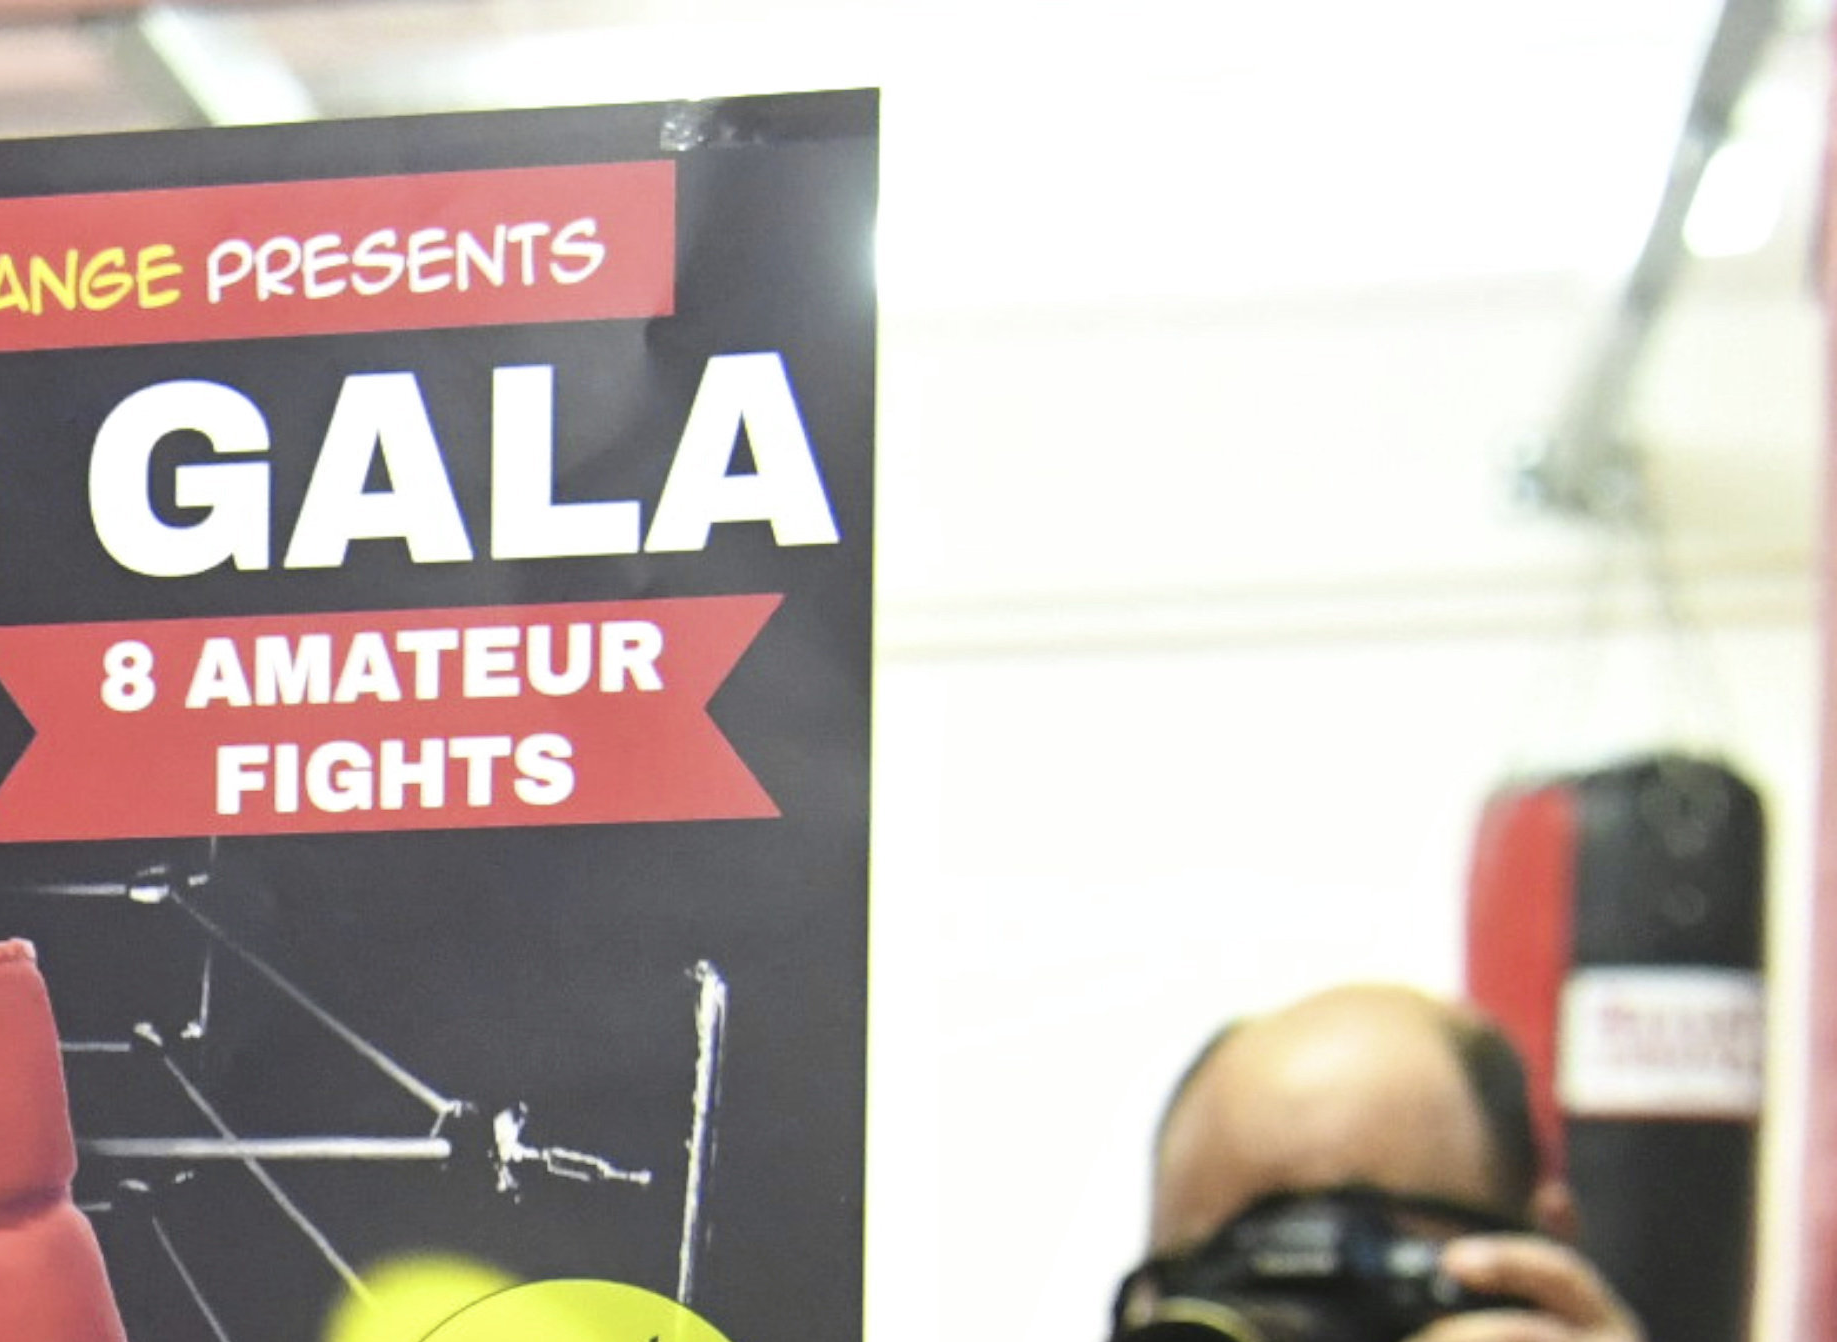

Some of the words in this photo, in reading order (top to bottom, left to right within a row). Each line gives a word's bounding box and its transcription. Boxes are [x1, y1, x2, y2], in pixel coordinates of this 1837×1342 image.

[206, 216, 608, 304] PRESENTS
[88, 350, 842, 578] GALA
[100, 640, 156, 712] 8
[185, 620, 664, 710] AMATEUR
[215, 734, 575, 816] FIGHTS
